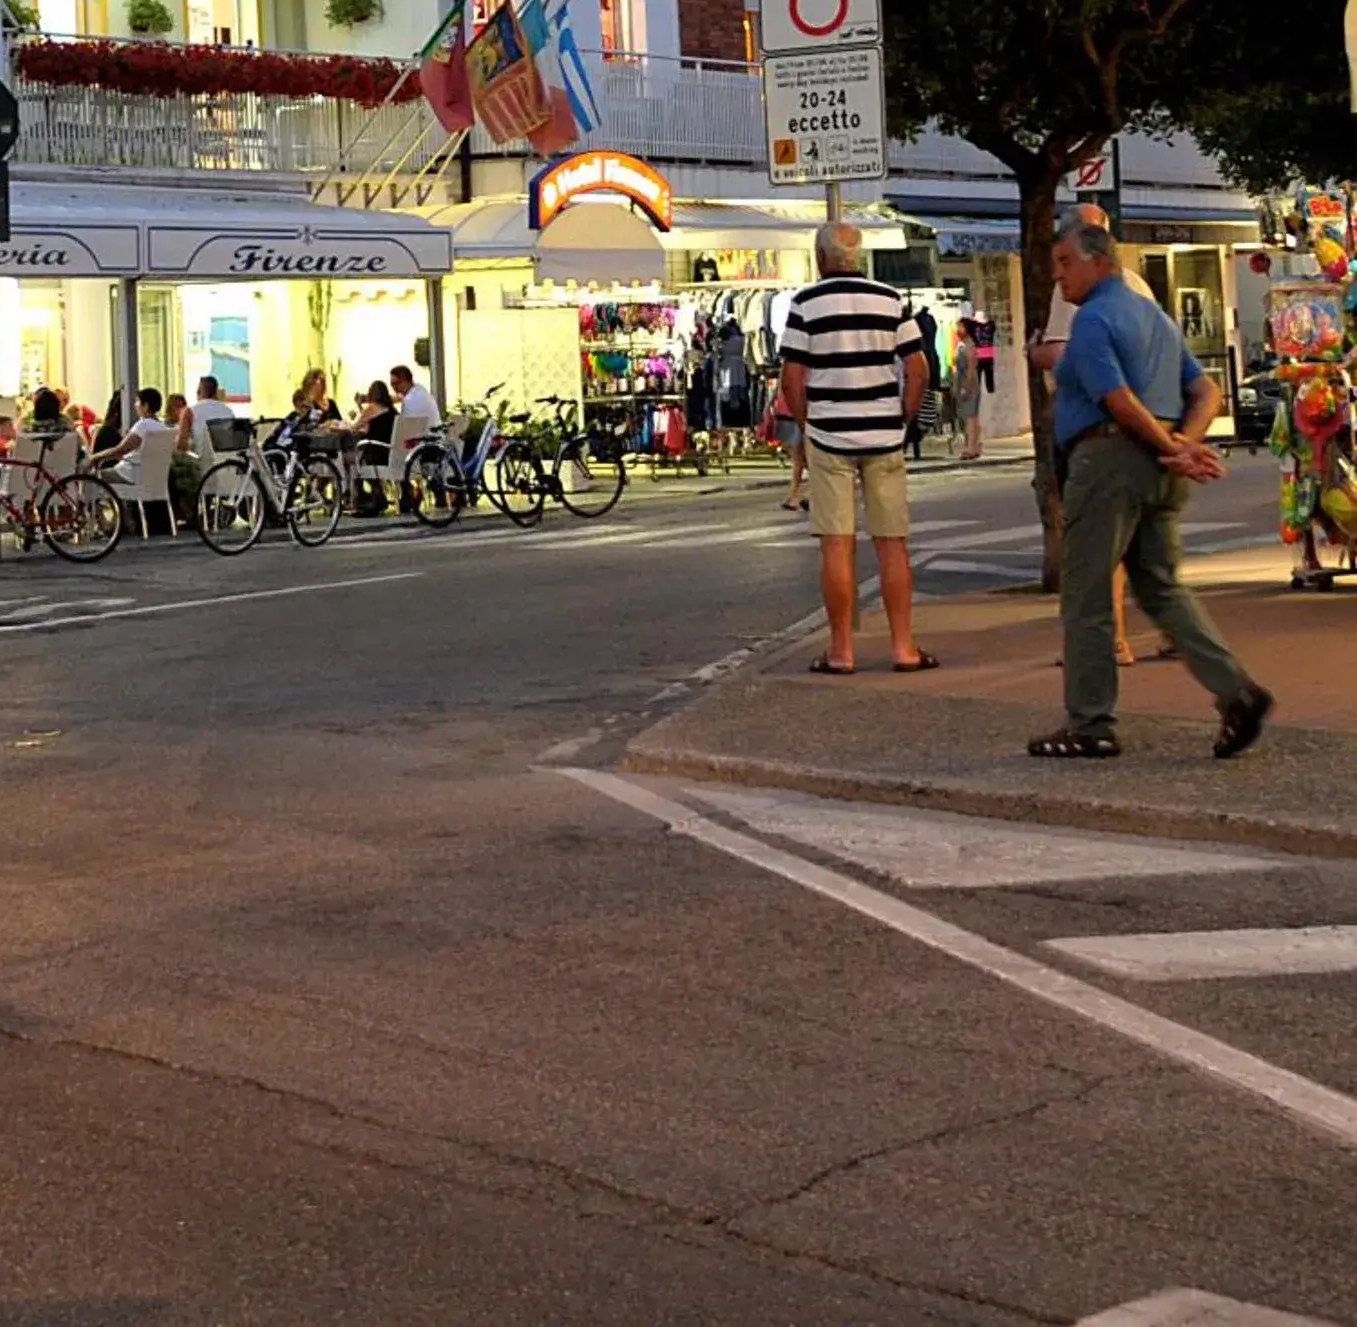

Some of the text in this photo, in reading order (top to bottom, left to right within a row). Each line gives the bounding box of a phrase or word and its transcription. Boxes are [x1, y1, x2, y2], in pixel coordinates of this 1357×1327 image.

[800, 89, 847, 109] 20-24
[788, 109, 861, 133] eccetto
[229, 244, 387, 272] Firenze
